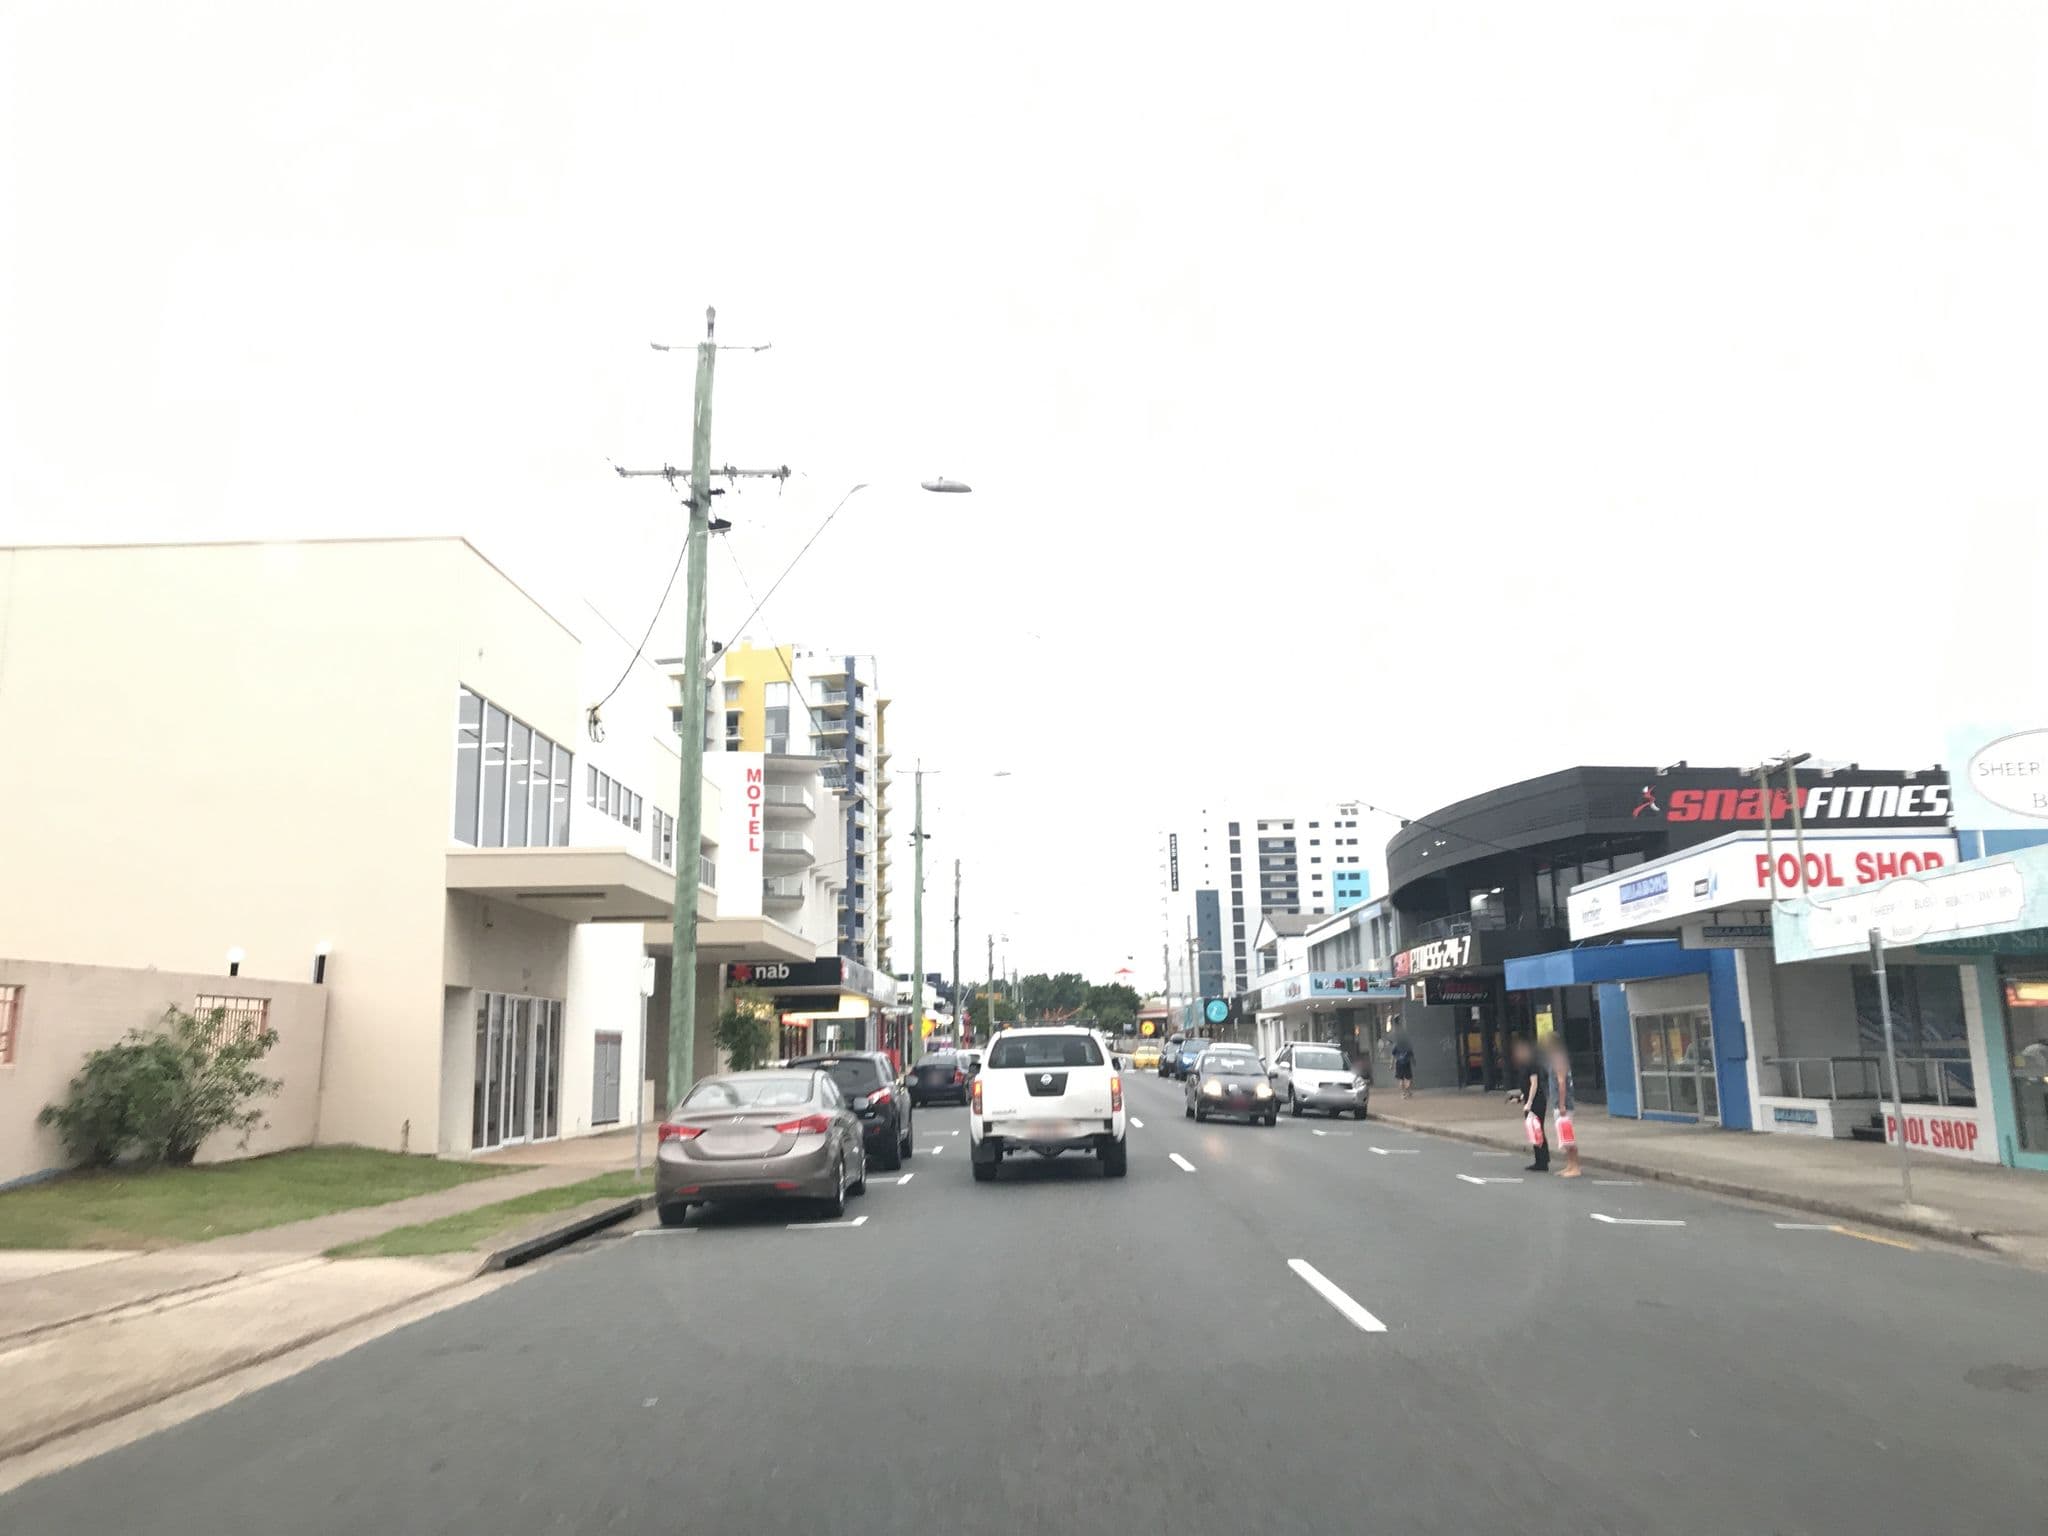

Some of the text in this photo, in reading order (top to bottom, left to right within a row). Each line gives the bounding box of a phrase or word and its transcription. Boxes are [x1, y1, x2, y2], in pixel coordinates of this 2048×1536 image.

[1978, 761, 2041, 777] SHEER
[746, 767, 762, 852] MOTEL
[1803, 784, 1955, 819] FITNES
[1755, 852, 1844, 889] POOL
[755, 963, 790, 980] nab
[1930, 1118, 1979, 1151] SHOP
